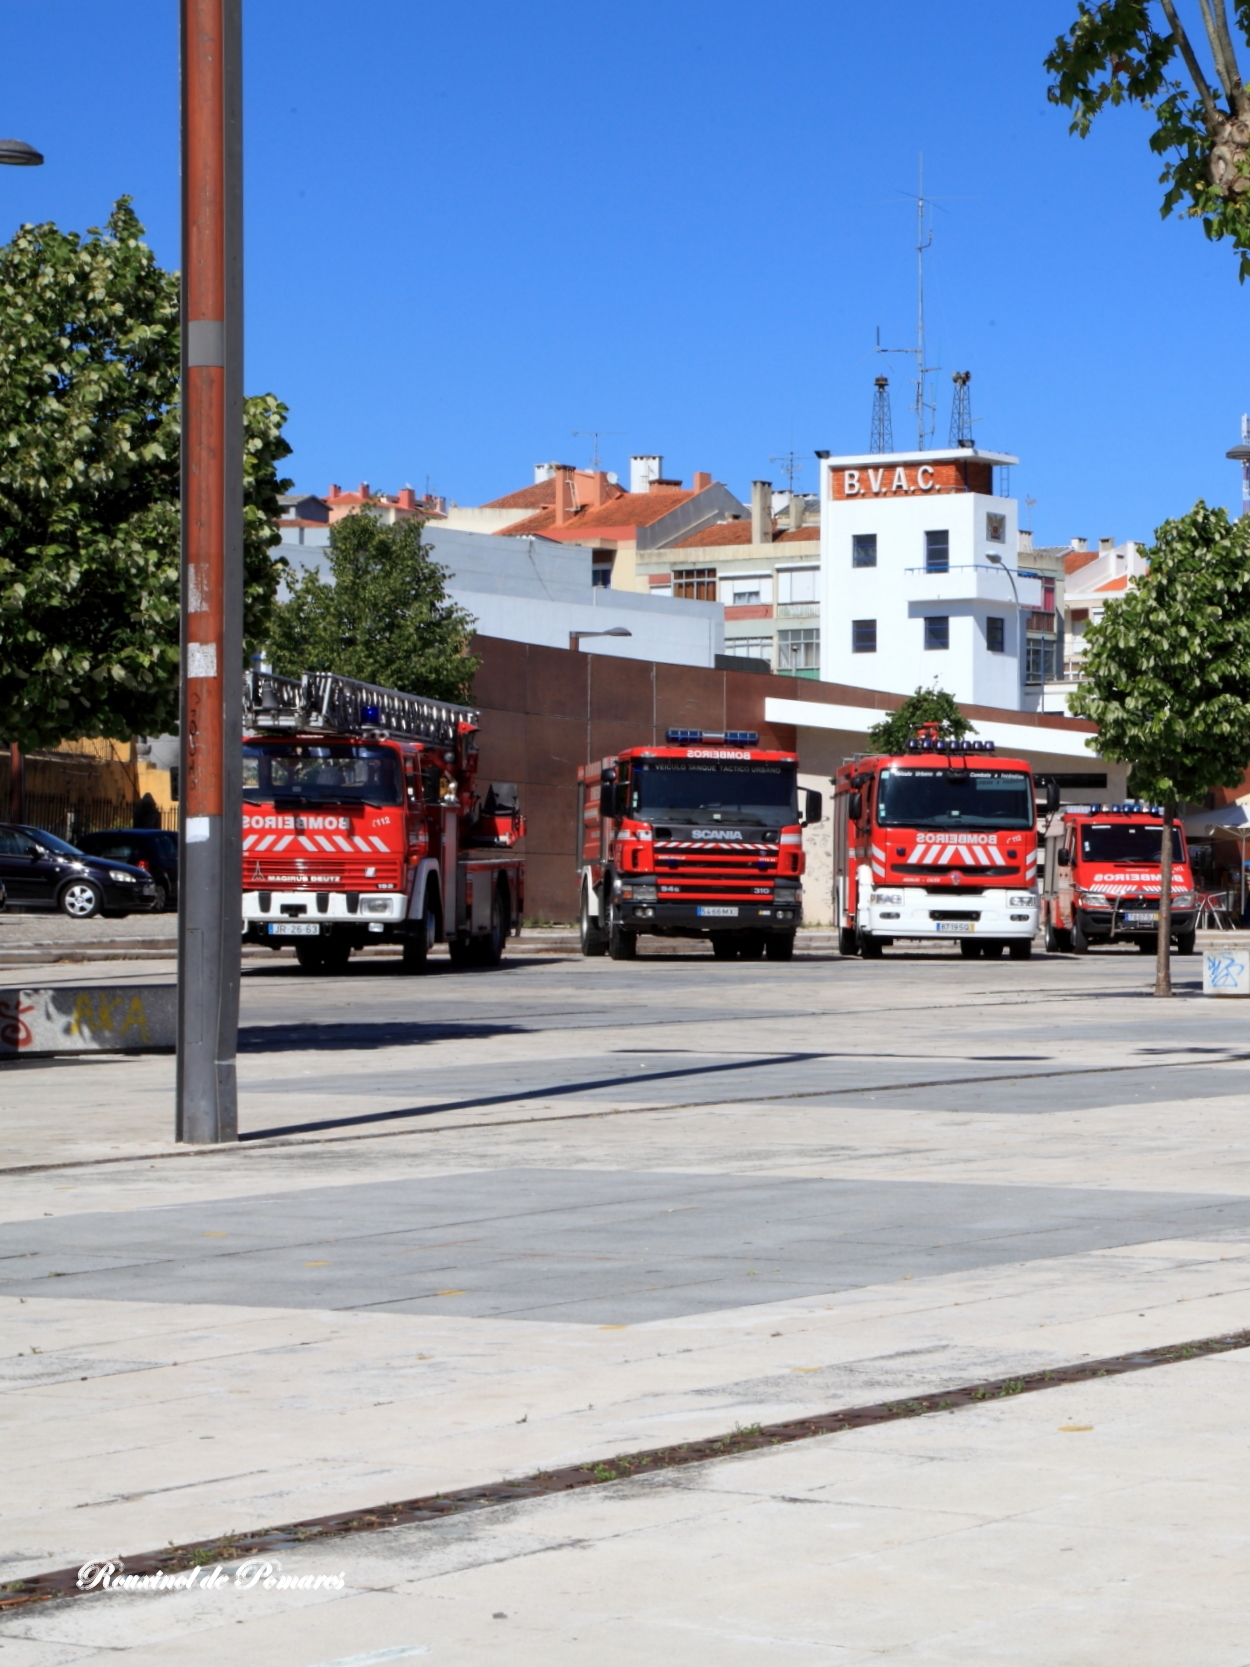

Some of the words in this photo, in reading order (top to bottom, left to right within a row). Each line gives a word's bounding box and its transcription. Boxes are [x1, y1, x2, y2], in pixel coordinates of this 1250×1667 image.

[844, 465, 942, 495] B.V.A.C.
[376, 817, 391, 827] 112
[692, 830, 743, 840] SCANIA
[1011, 835, 1022, 843] 112
